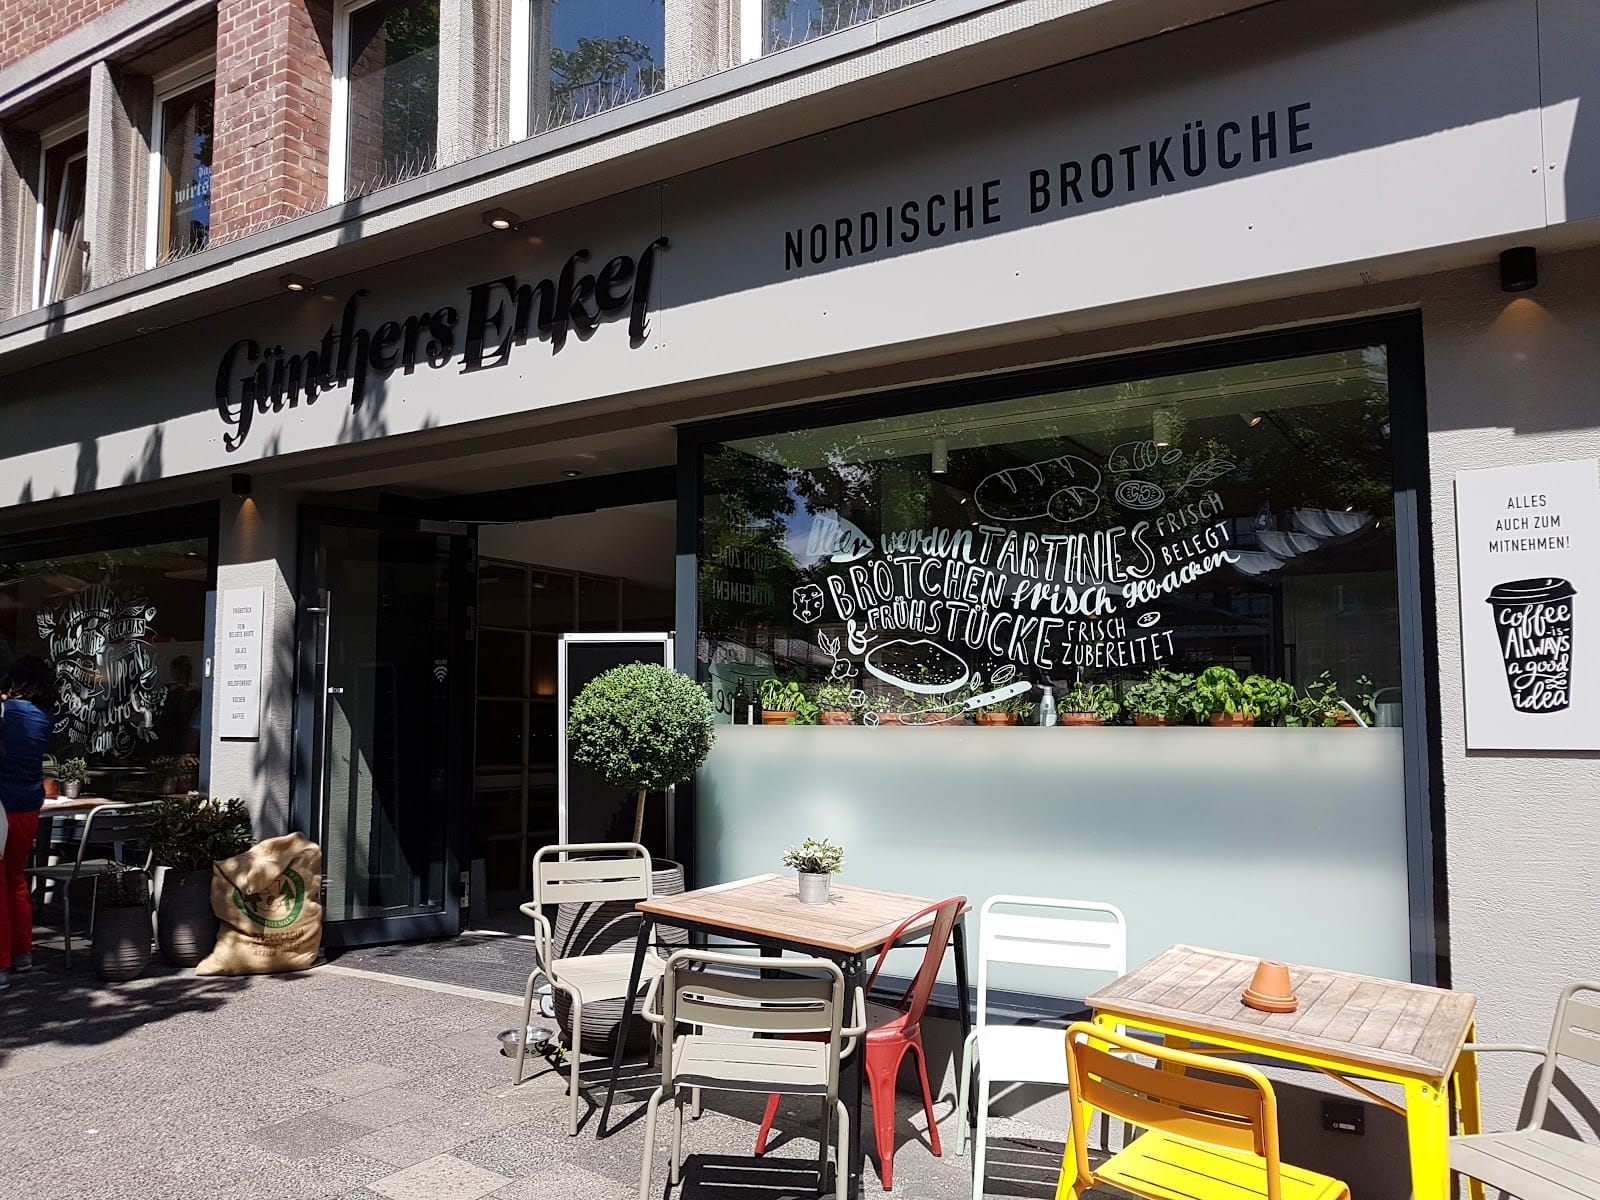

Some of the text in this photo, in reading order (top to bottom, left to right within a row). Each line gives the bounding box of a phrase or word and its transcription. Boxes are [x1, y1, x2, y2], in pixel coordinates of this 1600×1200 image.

[785, 102, 1313, 270] NORDISCHE BROTKÜCHE
[215, 236, 670, 452] Günthers Enkel
[1156, 492, 1224, 537] FRISCH
[1507, 494, 1547, 509] ALLES
[1496, 515, 1561, 531] AUCH ZUM
[881, 526, 976, 564] werden
[979, 521, 1155, 584] TARTINES
[1161, 520, 1230, 566] BELEGT
[1489, 536, 1570, 552] MITNEHMEN!
[827, 550, 1240, 620] BRÖTCHEN frisch gebacken
[60, 584, 120, 626] TARTINES
[1500, 604, 1571, 639] coffee
[847, 596, 1064, 669] & FRÜHSTÜCKE
[1061, 629, 1174, 668] ZUBEREITET
[1067, 617, 1126, 642] FRISCH
[1505, 627, 1570, 660] ALWAYS
[1509, 654, 1569, 689] a good
[1514, 681, 1569, 710] idea
